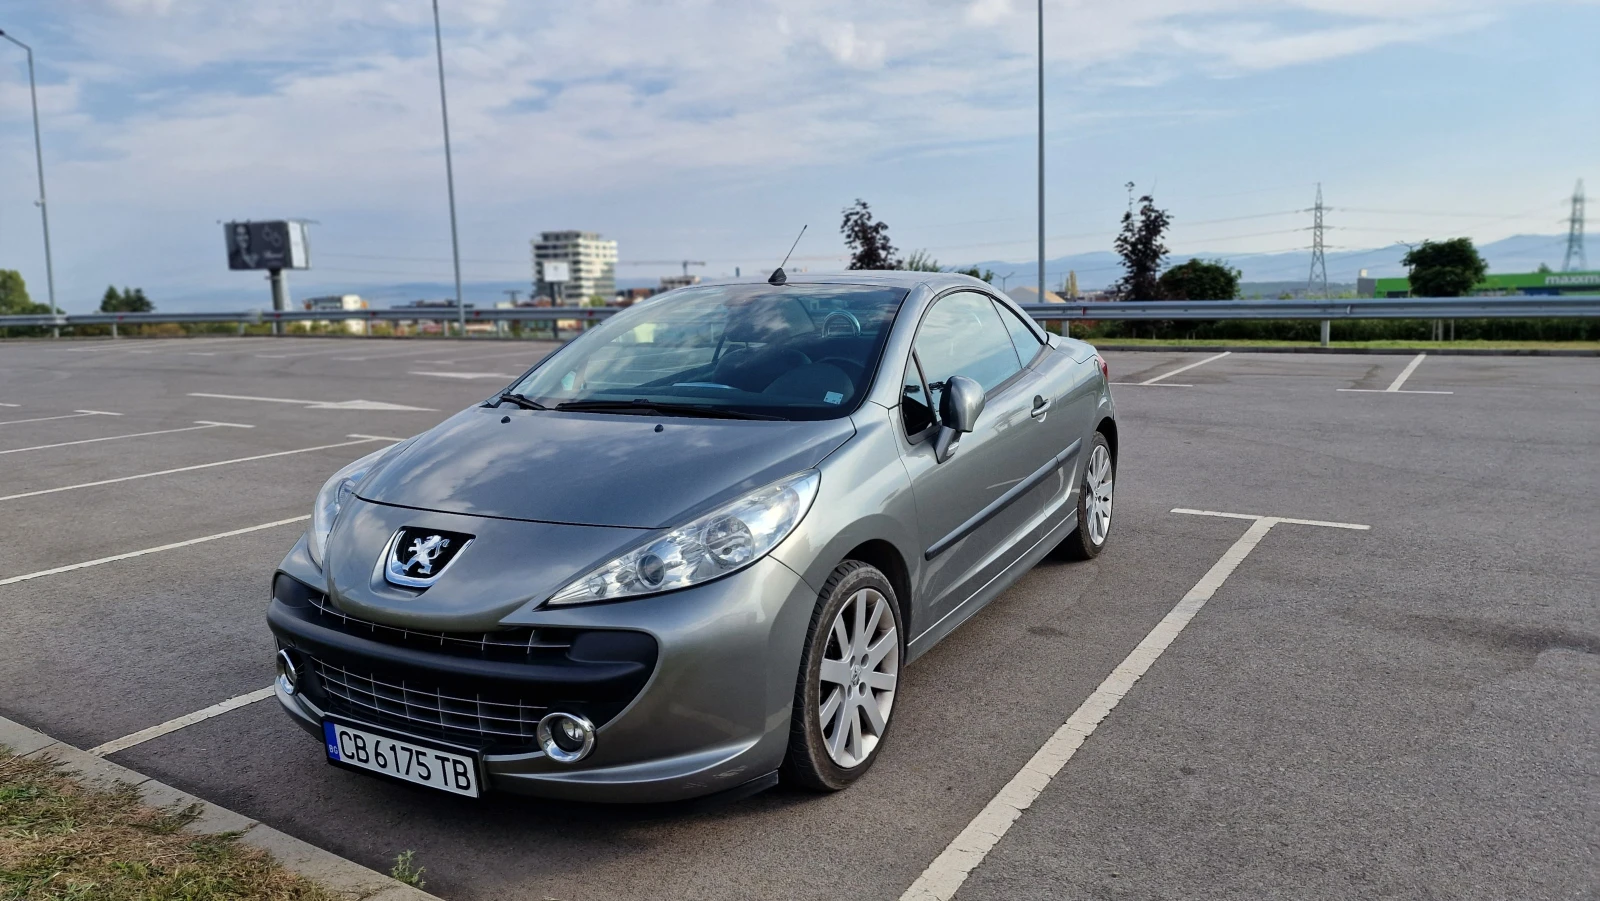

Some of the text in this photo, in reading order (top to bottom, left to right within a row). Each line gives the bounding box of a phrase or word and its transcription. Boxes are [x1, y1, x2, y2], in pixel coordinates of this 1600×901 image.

[328, 744, 339, 755] BG
[339, 730, 471, 791] CB 6175 TB
